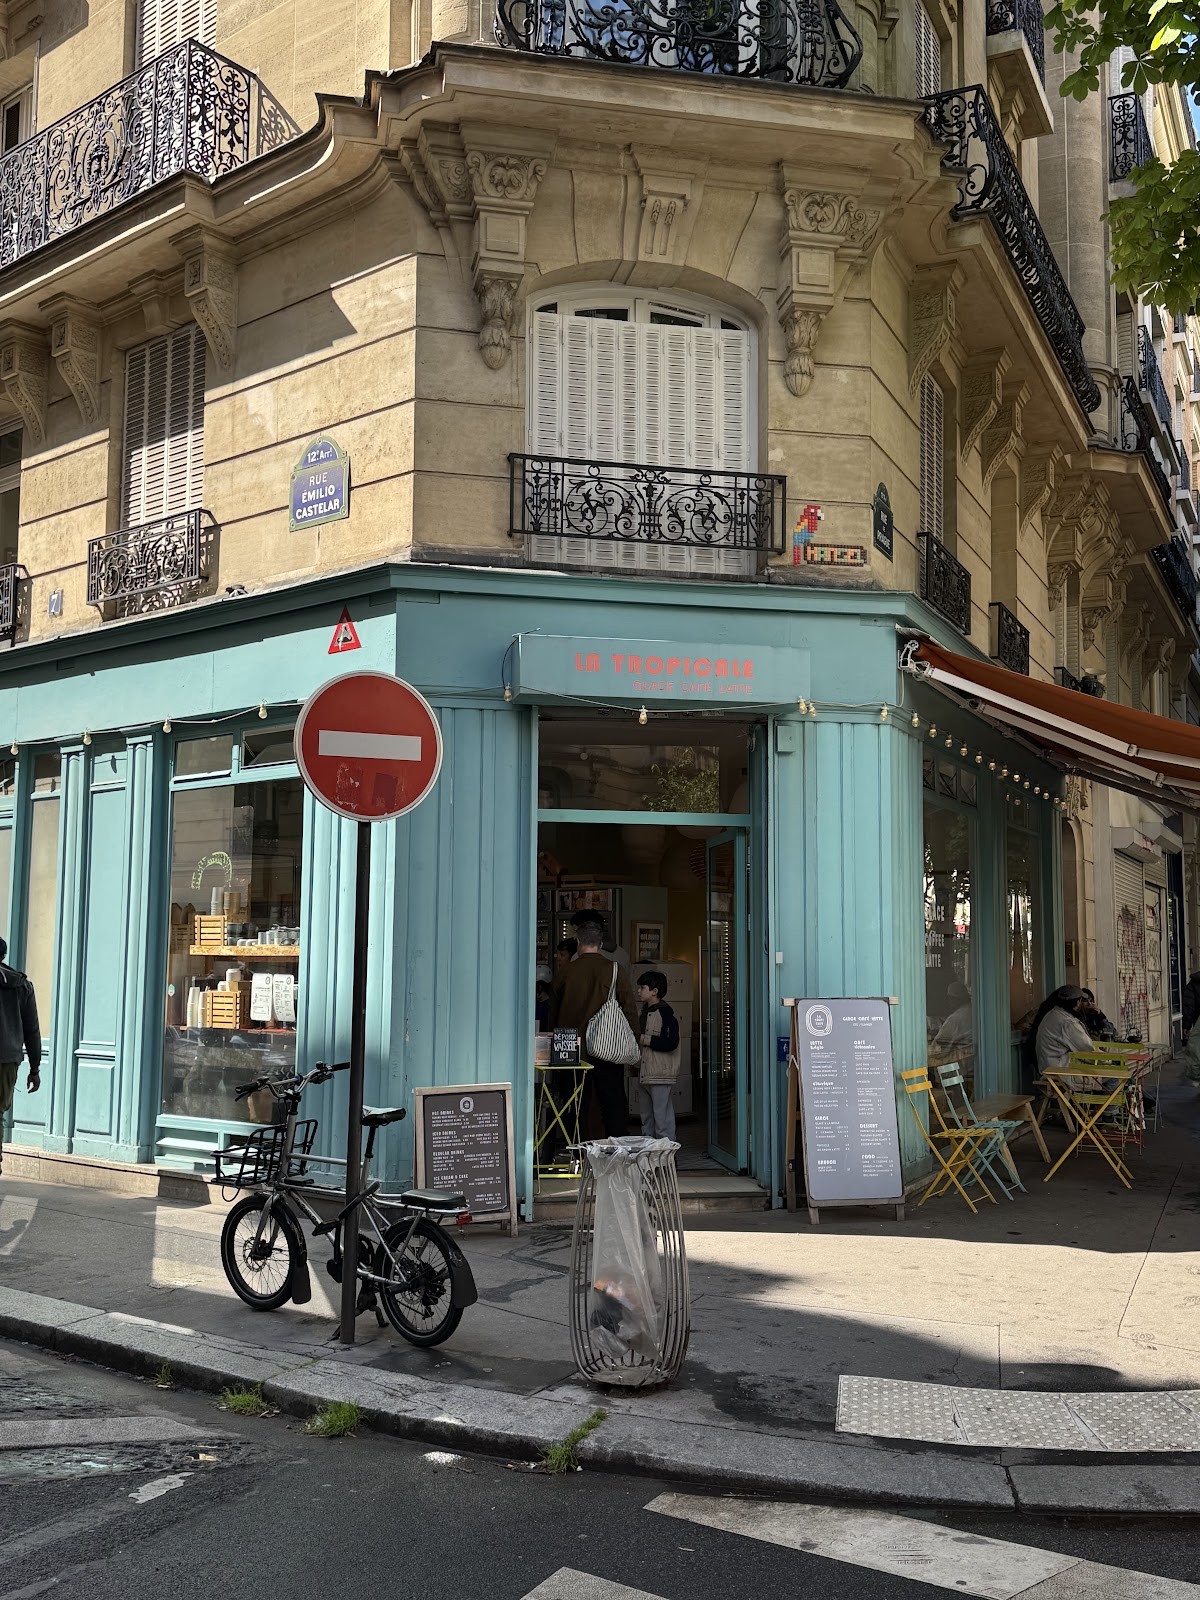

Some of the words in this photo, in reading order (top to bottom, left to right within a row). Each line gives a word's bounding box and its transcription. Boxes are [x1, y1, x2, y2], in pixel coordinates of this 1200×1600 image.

[309, 472, 328, 487] RUE
[301, 484, 335, 503] ÉMILIO
[295, 498, 340, 520] CASTELAR
[51, 593, 59, 613] 7
[575, 653, 600, 672] LA
[611, 654, 754, 679] TROPICALE
[633, 679, 673, 691] GLACE
[719, 683, 753, 695] LATTE
[925, 953, 941, 968] LATTE
